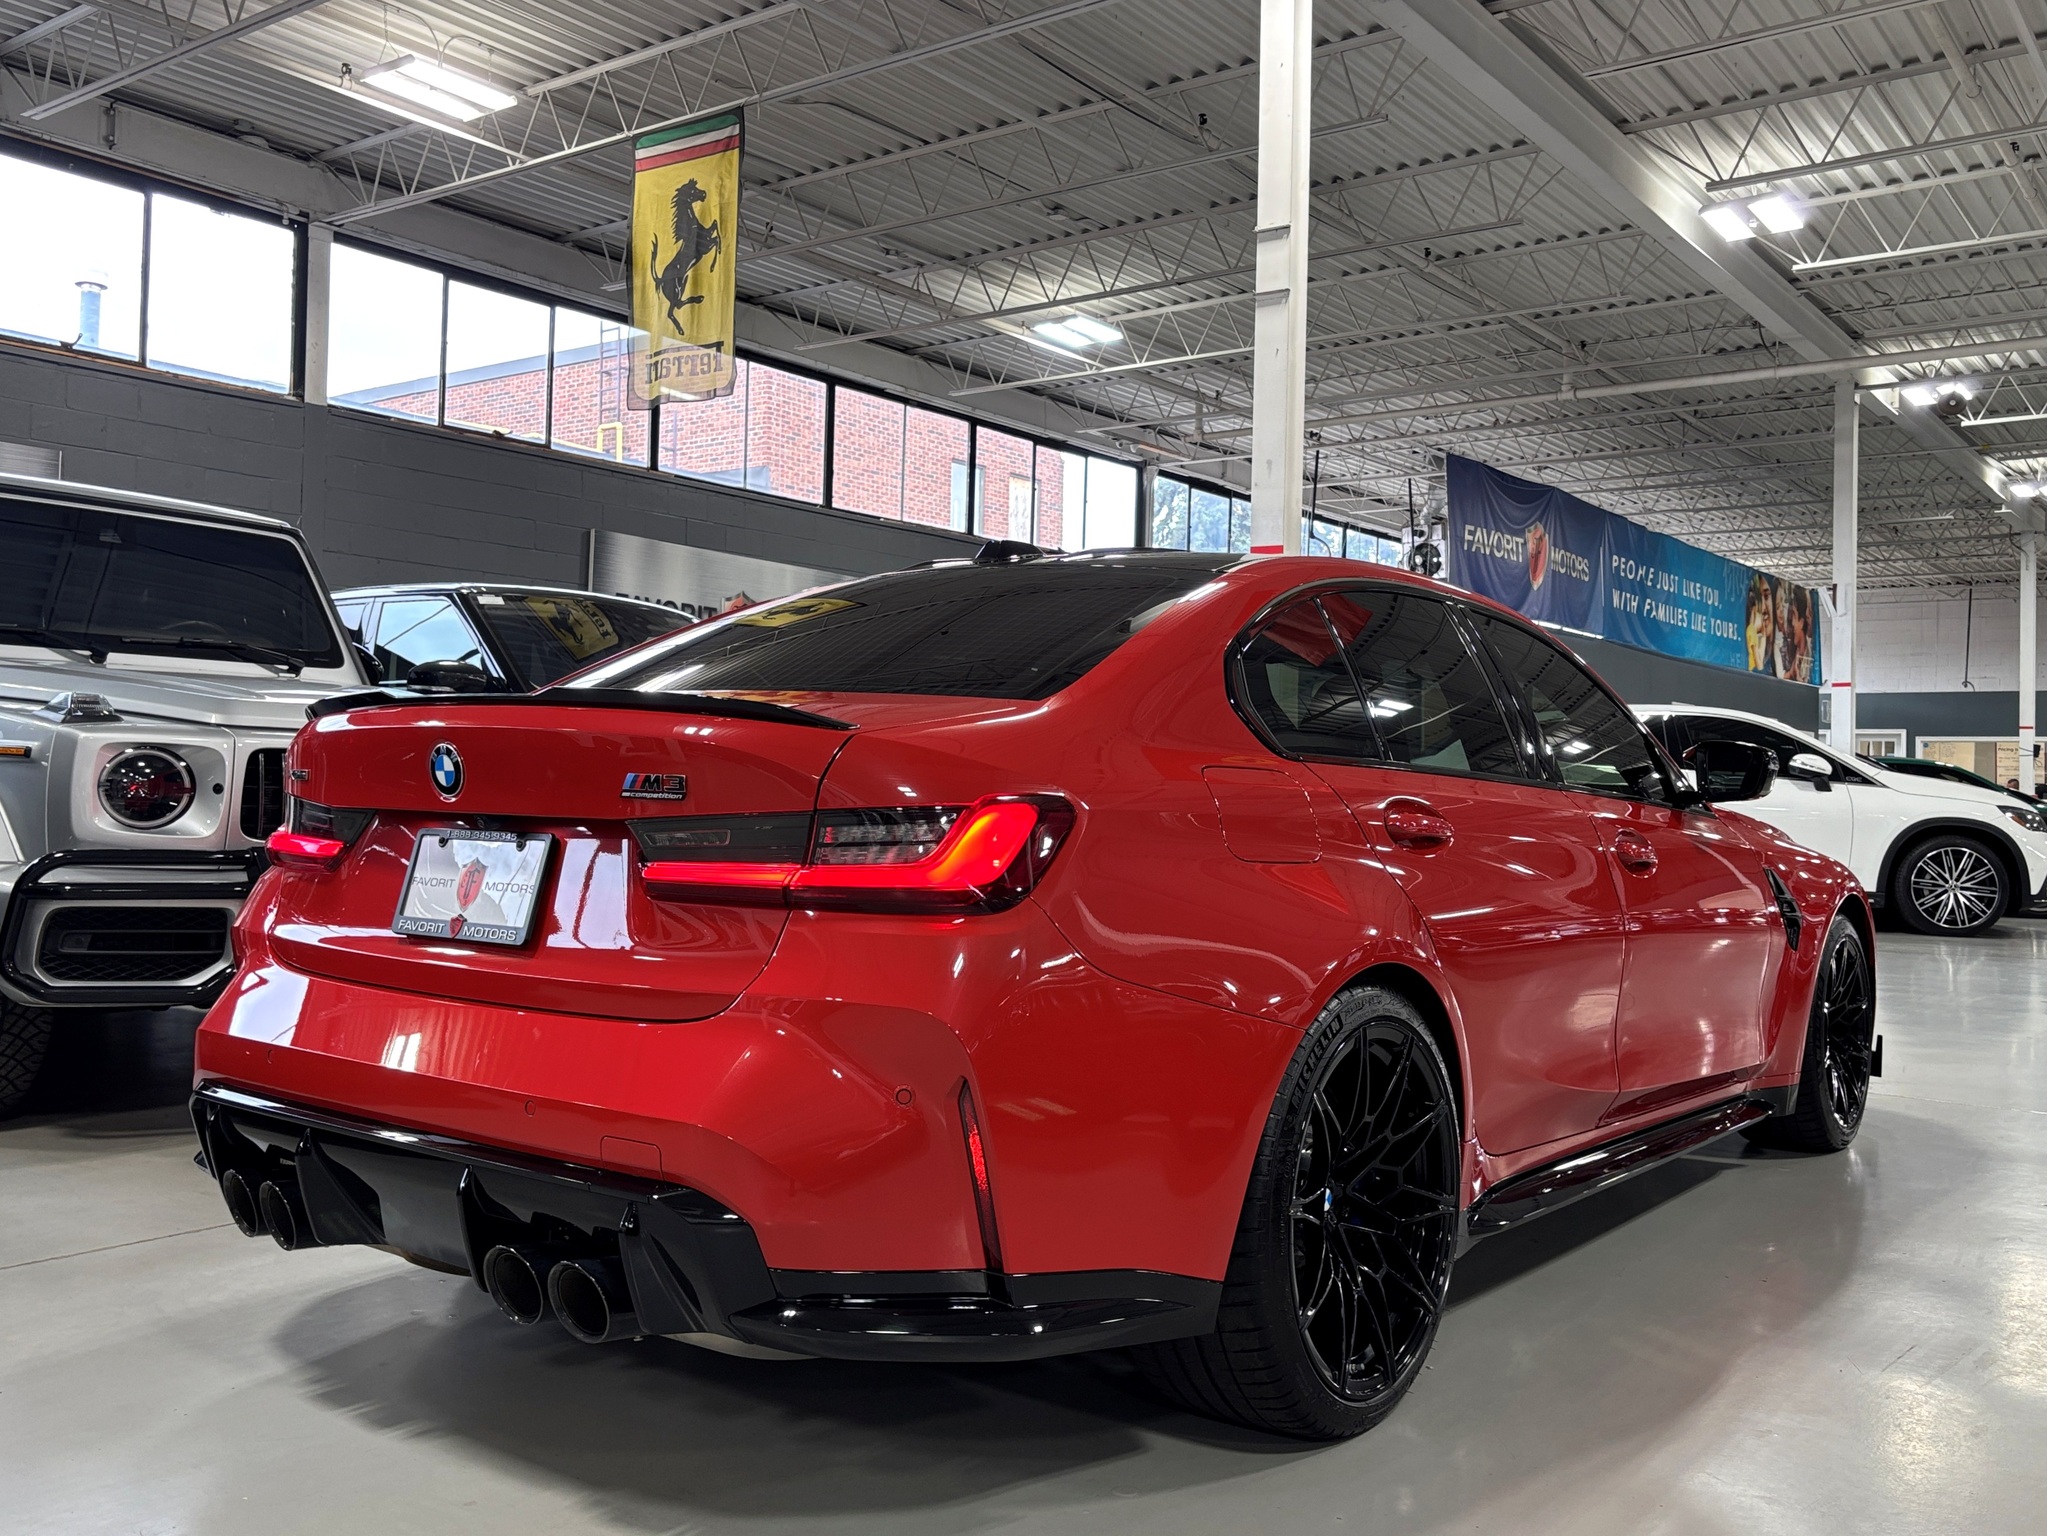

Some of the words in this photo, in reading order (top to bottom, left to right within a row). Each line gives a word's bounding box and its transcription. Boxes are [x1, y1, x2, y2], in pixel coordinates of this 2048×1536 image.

[1463, 524, 1524, 563] FAVORIT
[1551, 546, 1589, 582] MOTORS
[1657, 571, 1678, 594] JUST
[1683, 579, 1701, 600] LIKE
[1612, 588, 1638, 615] WITH
[1644, 599, 1687, 628] FAMILIES
[1691, 612, 1707, 633] LIKE
[1711, 618, 1741, 641] YOURS.
[630, 792, 683, 800] competition
[412, 876, 456, 888] FAVORIT
[484, 881, 535, 895] MOTORS
[398, 919, 445, 934] FAVORIT
[462, 926, 517, 941] MOTORS
[1291, 1017, 1340, 1109] MICHELIN
